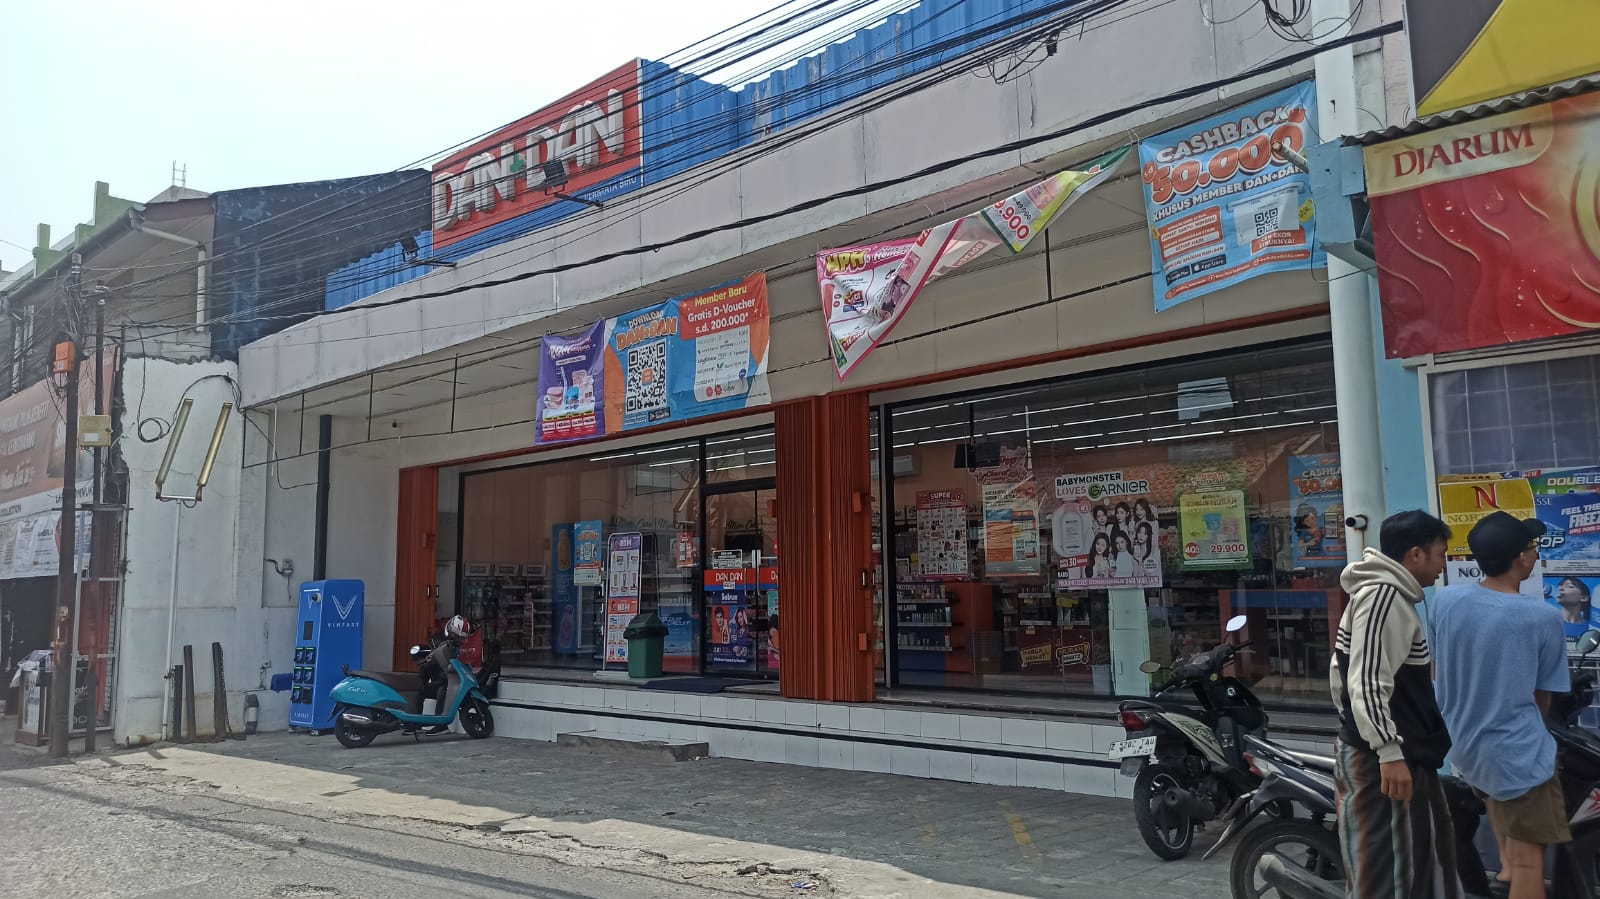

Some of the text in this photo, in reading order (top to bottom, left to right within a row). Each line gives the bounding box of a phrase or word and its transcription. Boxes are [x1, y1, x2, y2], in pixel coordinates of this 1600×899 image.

[1156, 104, 1290, 163] CASHBACK
[1393, 123, 1536, 178] DJARUM
[1151, 125, 1304, 204] 50.000
[1153, 200, 1192, 222] KHUSUS
[1192, 182, 1242, 206] MEMBER
[694, 285, 748, 307] Member Baru
[688, 298, 756, 323] Gratis D-Voucher
[695, 323, 710, 335] s.d.
[1056, 472, 1122, 488] BABYMONSTER
[1547, 475, 1600, 487] DOUBLE
[930, 491, 951, 501] SUPER
[1057, 480, 1149, 499] LOVES GARNIER
[1471, 482, 1501, 510] N
[1561, 506, 1582, 517] FEEL
[1210, 543, 1245, 554] 29.900
[1540, 536, 1565, 550] OP
[716, 571, 743, 582] DAN DAN
